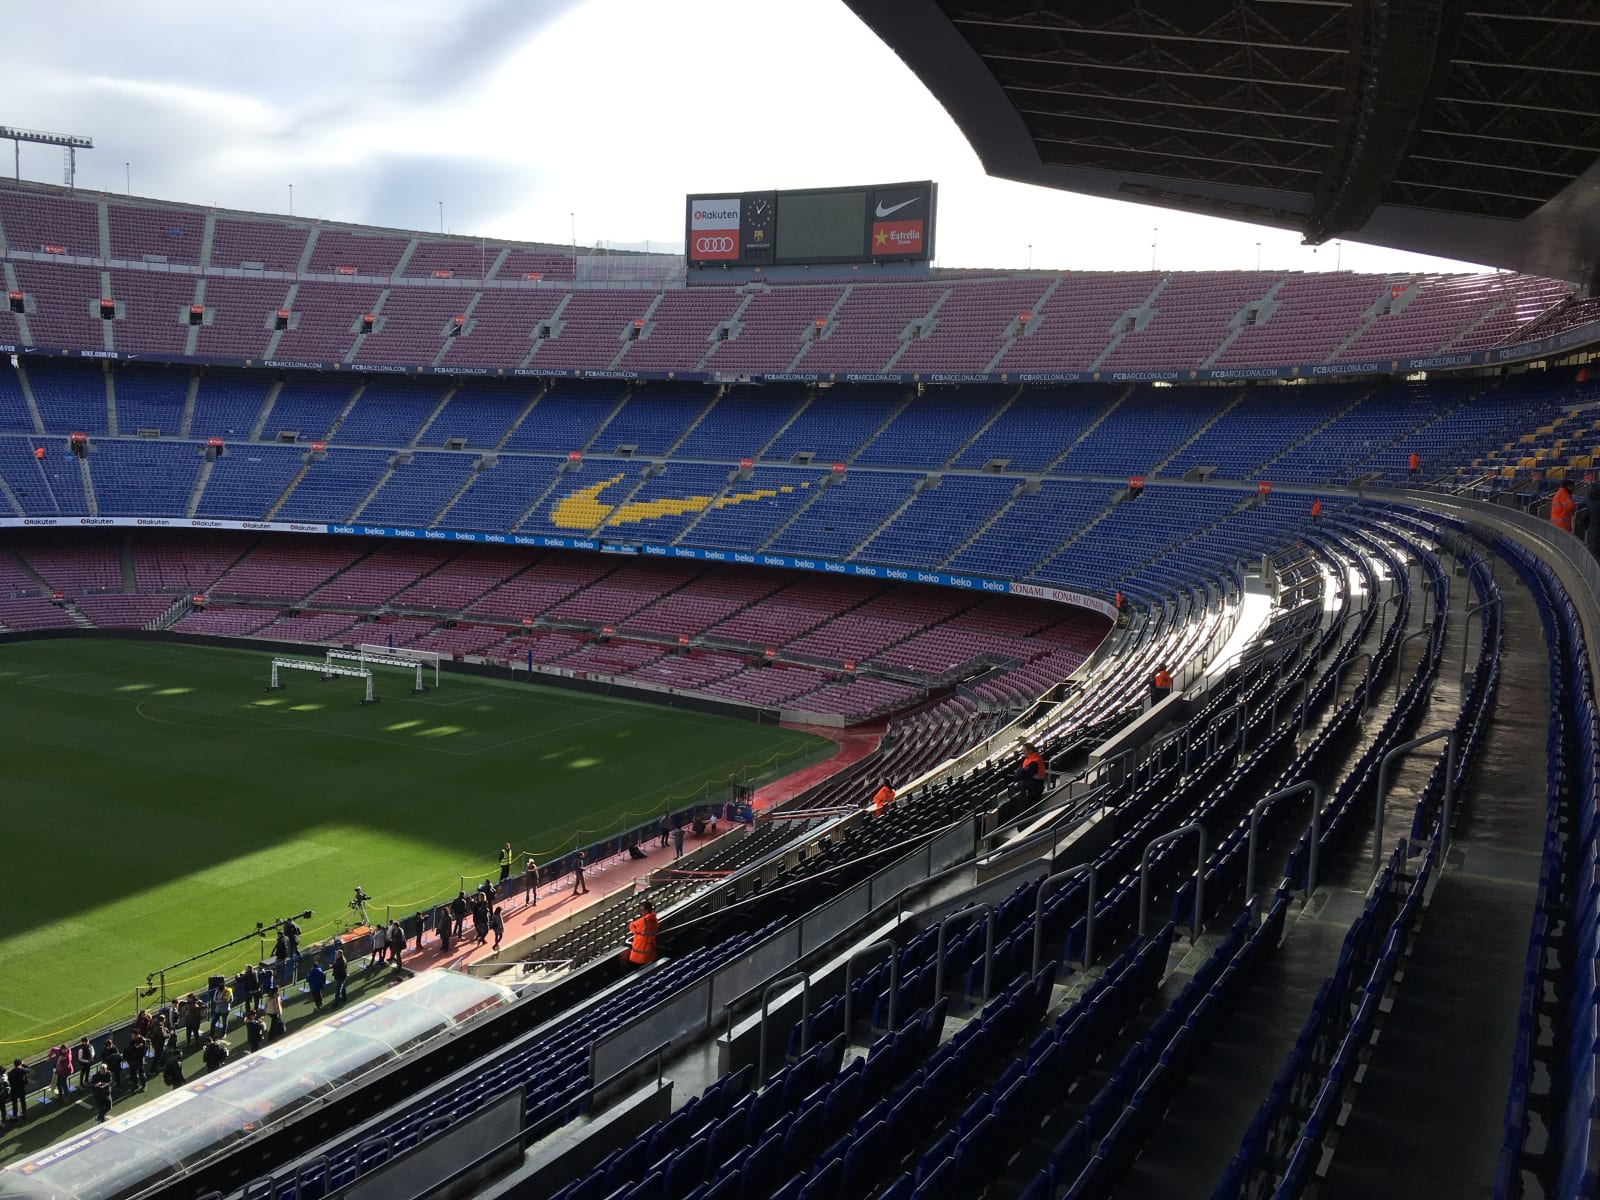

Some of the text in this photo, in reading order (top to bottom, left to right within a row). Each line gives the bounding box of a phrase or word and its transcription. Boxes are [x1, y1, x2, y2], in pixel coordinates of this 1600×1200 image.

[702, 210, 738, 220] Rakuten
[889, 230, 920, 240] Estrella
[264, 360, 322, 369] FCBARCELONA.COM
[1410, 355, 1472, 368] FCBARCELONA.COM
[351, 364, 407, 372] FCBARCELONA.COM
[434, 367, 487, 375] FCBARCELONA.COM
[1312, 363, 1378, 375] FCBARCELONA.COM
[514, 369, 568, 377] FCBARCELONA.COM
[585, 370, 638, 378] FCBARCELONA.COM
[1113, 372, 1178, 380] FCBARCELONA.COM
[1211, 369, 1278, 378] FCBARCELONA.COM
[516, 536, 535, 544] beko
[545, 538, 565, 546] beko
[647, 546, 666, 554] beko
[676, 549, 695, 557] beko
[705, 551, 725, 559] beko
[735, 554, 755, 562] beko
[765, 557, 785, 565] beko
[795, 560, 815, 568] beko
[826, 563, 845, 571] beko
[856, 566, 876, 575] beko
[887, 569, 908, 578] beko
[919, 573, 940, 582] beko
[951, 577, 972, 586] beko
[983, 581, 1005, 590] beko
[1010, 583, 1044, 597] KONAMI
[1052, 590, 1080, 603] KONAMI
